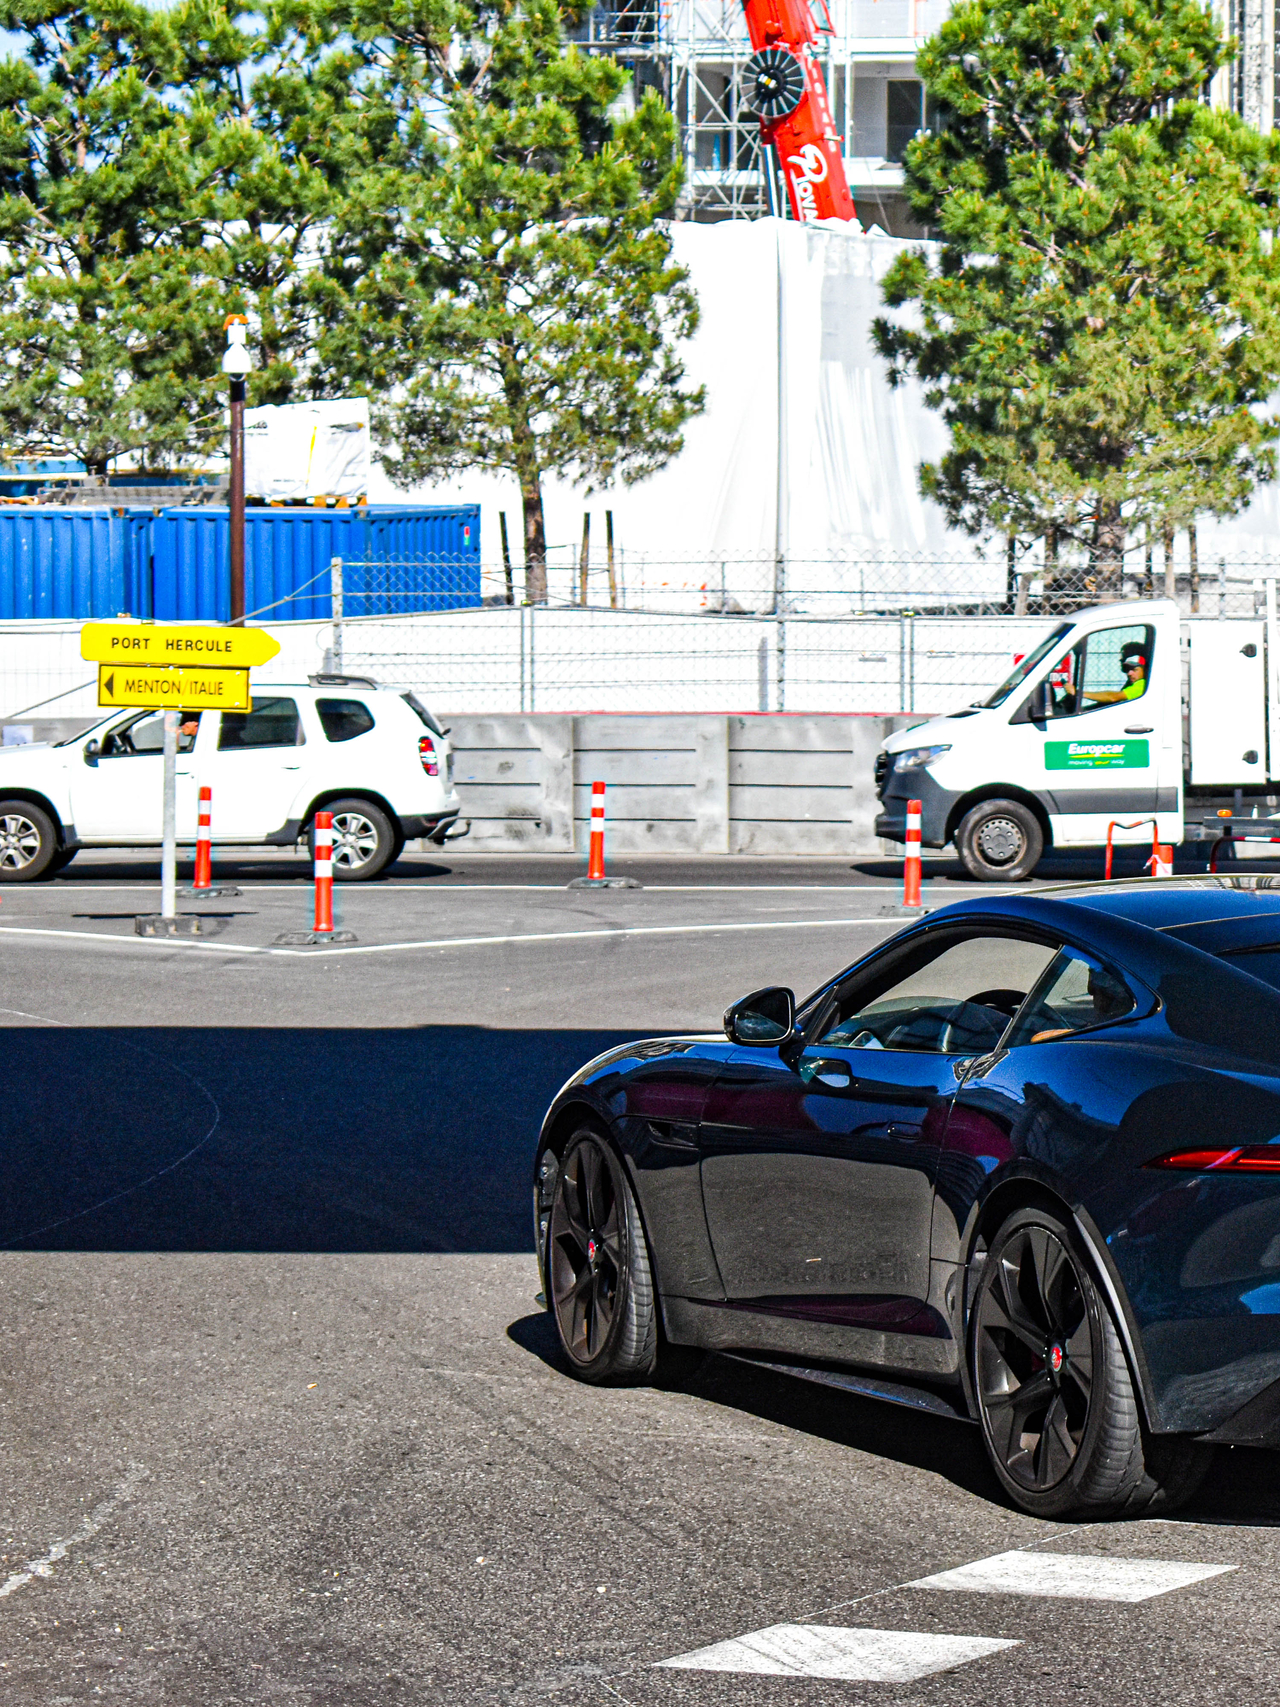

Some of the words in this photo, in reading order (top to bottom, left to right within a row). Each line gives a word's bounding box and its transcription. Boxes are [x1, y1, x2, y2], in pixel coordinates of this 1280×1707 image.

[111, 637, 151, 650] PORT
[165, 638, 233, 652] HERCULE
[124, 679, 223, 695] MENTON/ITALIE
[1068, 743, 1125, 757] Europcar
